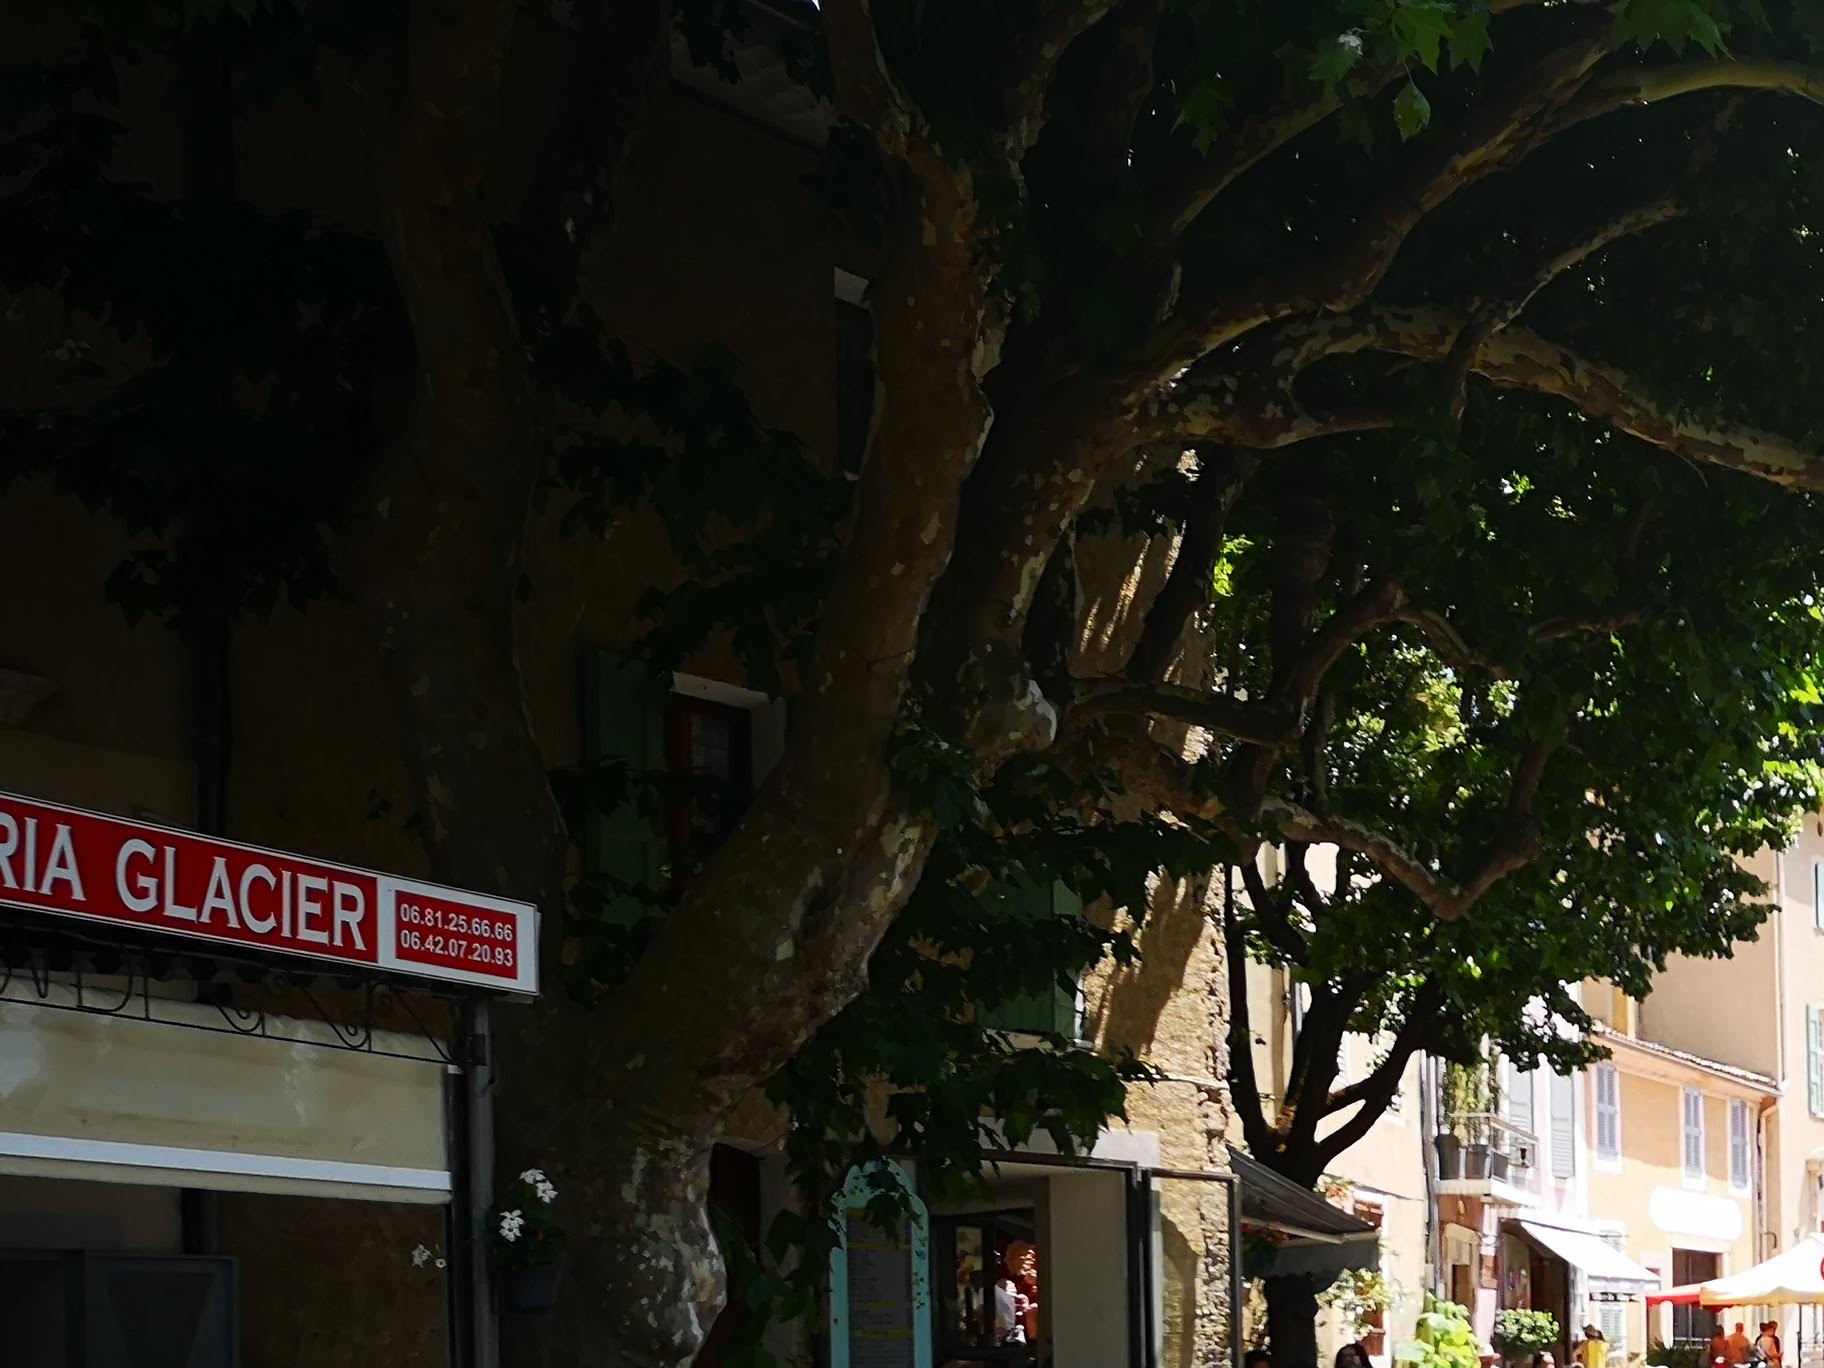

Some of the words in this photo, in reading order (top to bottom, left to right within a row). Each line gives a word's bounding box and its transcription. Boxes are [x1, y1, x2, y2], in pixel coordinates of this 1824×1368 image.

[116, 839, 367, 950] GLACIER
[400, 904, 513, 941] 06.81.25.66.66
[400, 930, 513, 967] 06.42.07.20.93
